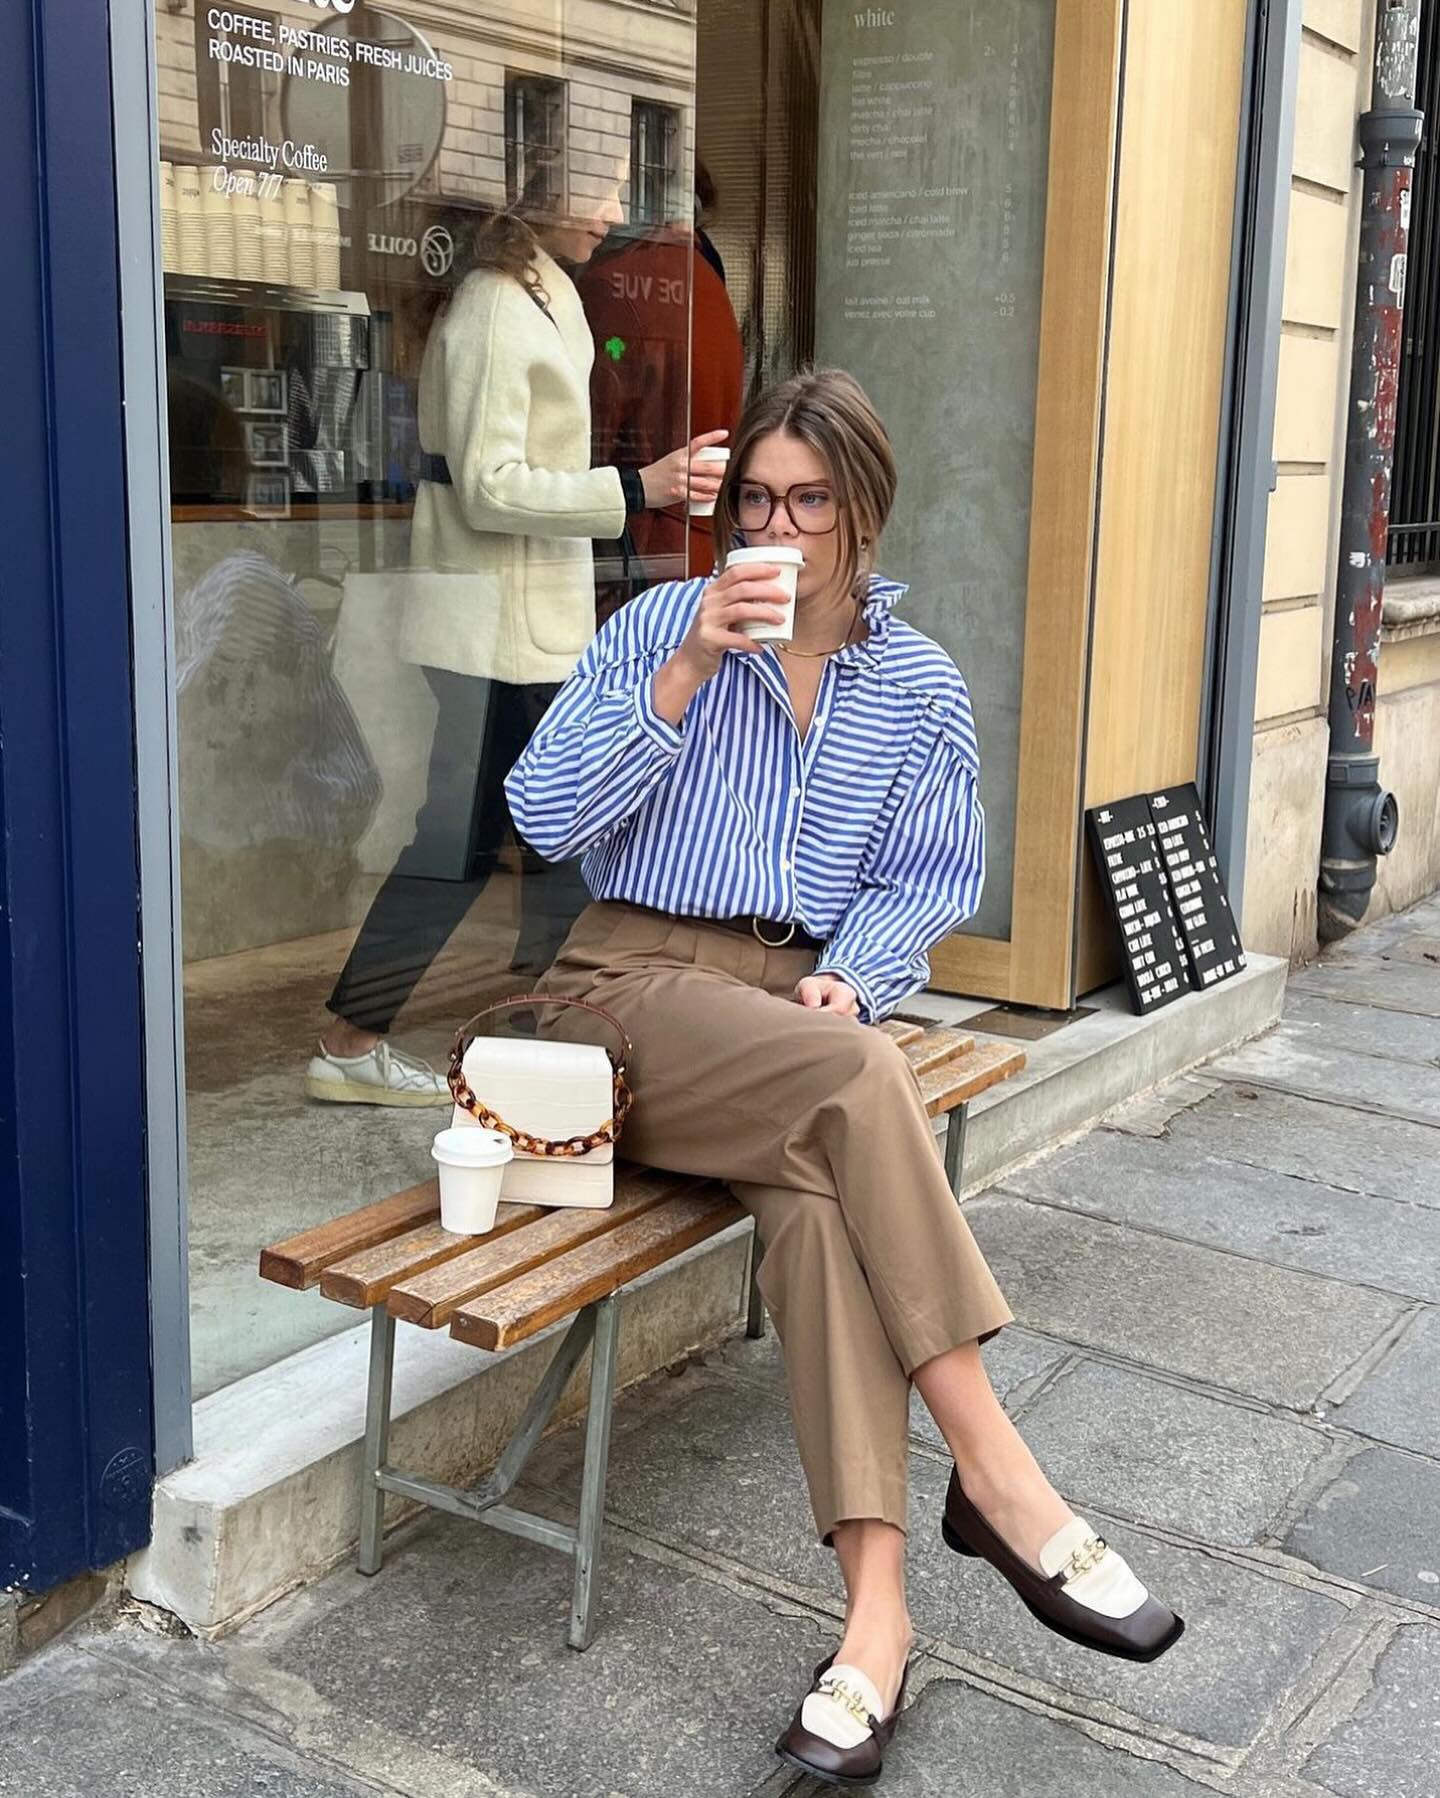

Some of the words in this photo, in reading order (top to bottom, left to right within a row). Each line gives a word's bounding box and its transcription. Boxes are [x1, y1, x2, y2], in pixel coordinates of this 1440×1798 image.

[854, 7, 896, 29] white
[208, 9, 275, 45] COFFEE,
[279, 25, 353, 62] PASTRIES,
[356, 43, 402, 71] FRESH
[404, 54, 453, 81] JUICES
[209, 39, 283, 72] ROASTED
[287, 56, 302, 77] IN
[307, 60, 350, 87] PARIS
[212, 128, 280, 170] Specialty
[282, 140, 328, 172] Coffee
[213, 166, 255, 199] Open
